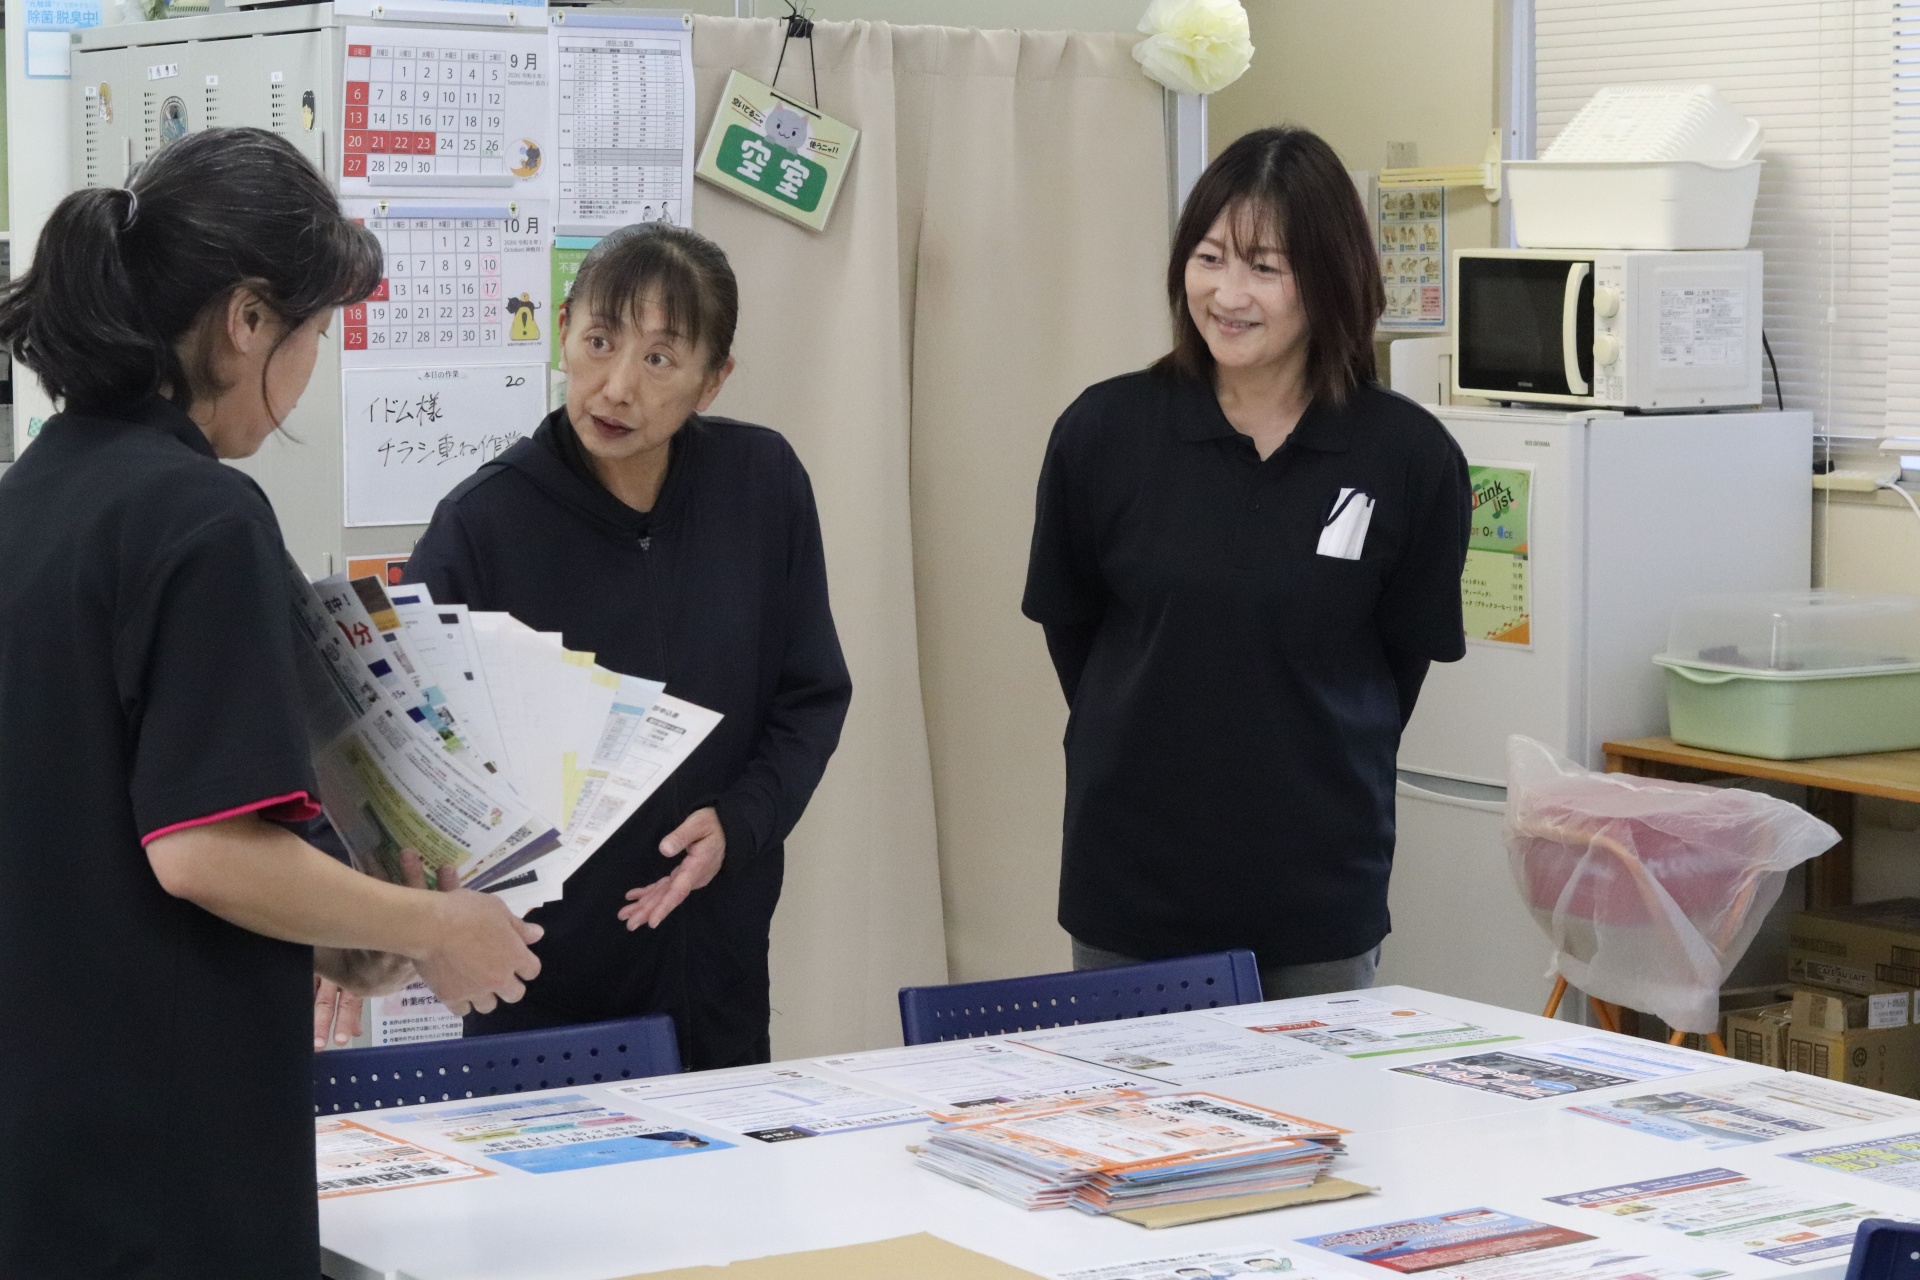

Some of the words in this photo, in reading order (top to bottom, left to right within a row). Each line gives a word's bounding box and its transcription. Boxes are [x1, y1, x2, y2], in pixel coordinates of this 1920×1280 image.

[510, 54, 518, 68] 9
[524, 53, 537, 71] 月
[402, 67, 406, 77] 1
[424, 67, 430, 78] 2
[447, 68, 453, 79] 3
[469, 69, 475, 80] 4
[492, 70, 498, 81] 5
[354, 88, 361, 100] 6
[377, 89, 383, 100] 7
[400, 90, 407, 101] 8
[423, 91, 429, 102] 9
[443, 92, 455, 103] 10
[466, 93, 477, 103] 11
[489, 93, 500, 104] 12
[350, 112, 362, 123] 13
[374, 113, 386, 124] 14
[397, 114, 408, 124] 15
[419, 115, 431, 125] 16
[442, 115, 454, 126] 17
[465, 116, 477, 127] 18
[488, 117, 500, 128] 19
[348, 136, 362, 147] 20
[372, 136, 384, 147] 21
[395, 137, 408, 148] 22
[418, 138, 430, 149] 23
[441, 139, 453, 150] 24
[463, 140, 476, 151] 25
[486, 140, 498, 151] 26
[348, 160, 361, 171] 27
[372, 161, 385, 172] 28
[394, 161, 407, 172] 29
[418, 162, 430, 173] 30
[736, 139, 810, 200] 空室
[503, 219, 519, 233] 10
[526, 217, 539, 234] 月
[443, 237, 447, 247] 1
[464, 237, 470, 247] 2
[486, 236, 492, 247] 3
[397, 261, 403, 271] 6
[420, 260, 426, 271] 7
[442, 260, 449, 271] 8
[464, 260, 471, 270] 9
[484, 259, 496, 270] 10
[394, 284, 406, 295] 13
[417, 284, 429, 295] 14
[440, 284, 451, 295] 15
[462, 284, 474, 294] 16
[485, 283, 497, 294] 17
[349, 309, 362, 320] 18
[372, 308, 385, 319] 19
[395, 308, 408, 319] 20
[418, 308, 429, 319] 21
[440, 307, 453, 318] 22
[462, 307, 475, 318] 23
[484, 306, 497, 317] 24
[349, 332, 362, 343] 25
[372, 332, 385, 343] 26
[395, 332, 407, 343] 27
[417, 331, 430, 342] 28
[440, 331, 453, 342] 29
[462, 331, 475, 341] 30
[485, 329, 496, 340] 31
[505, 375, 525, 388] 20
